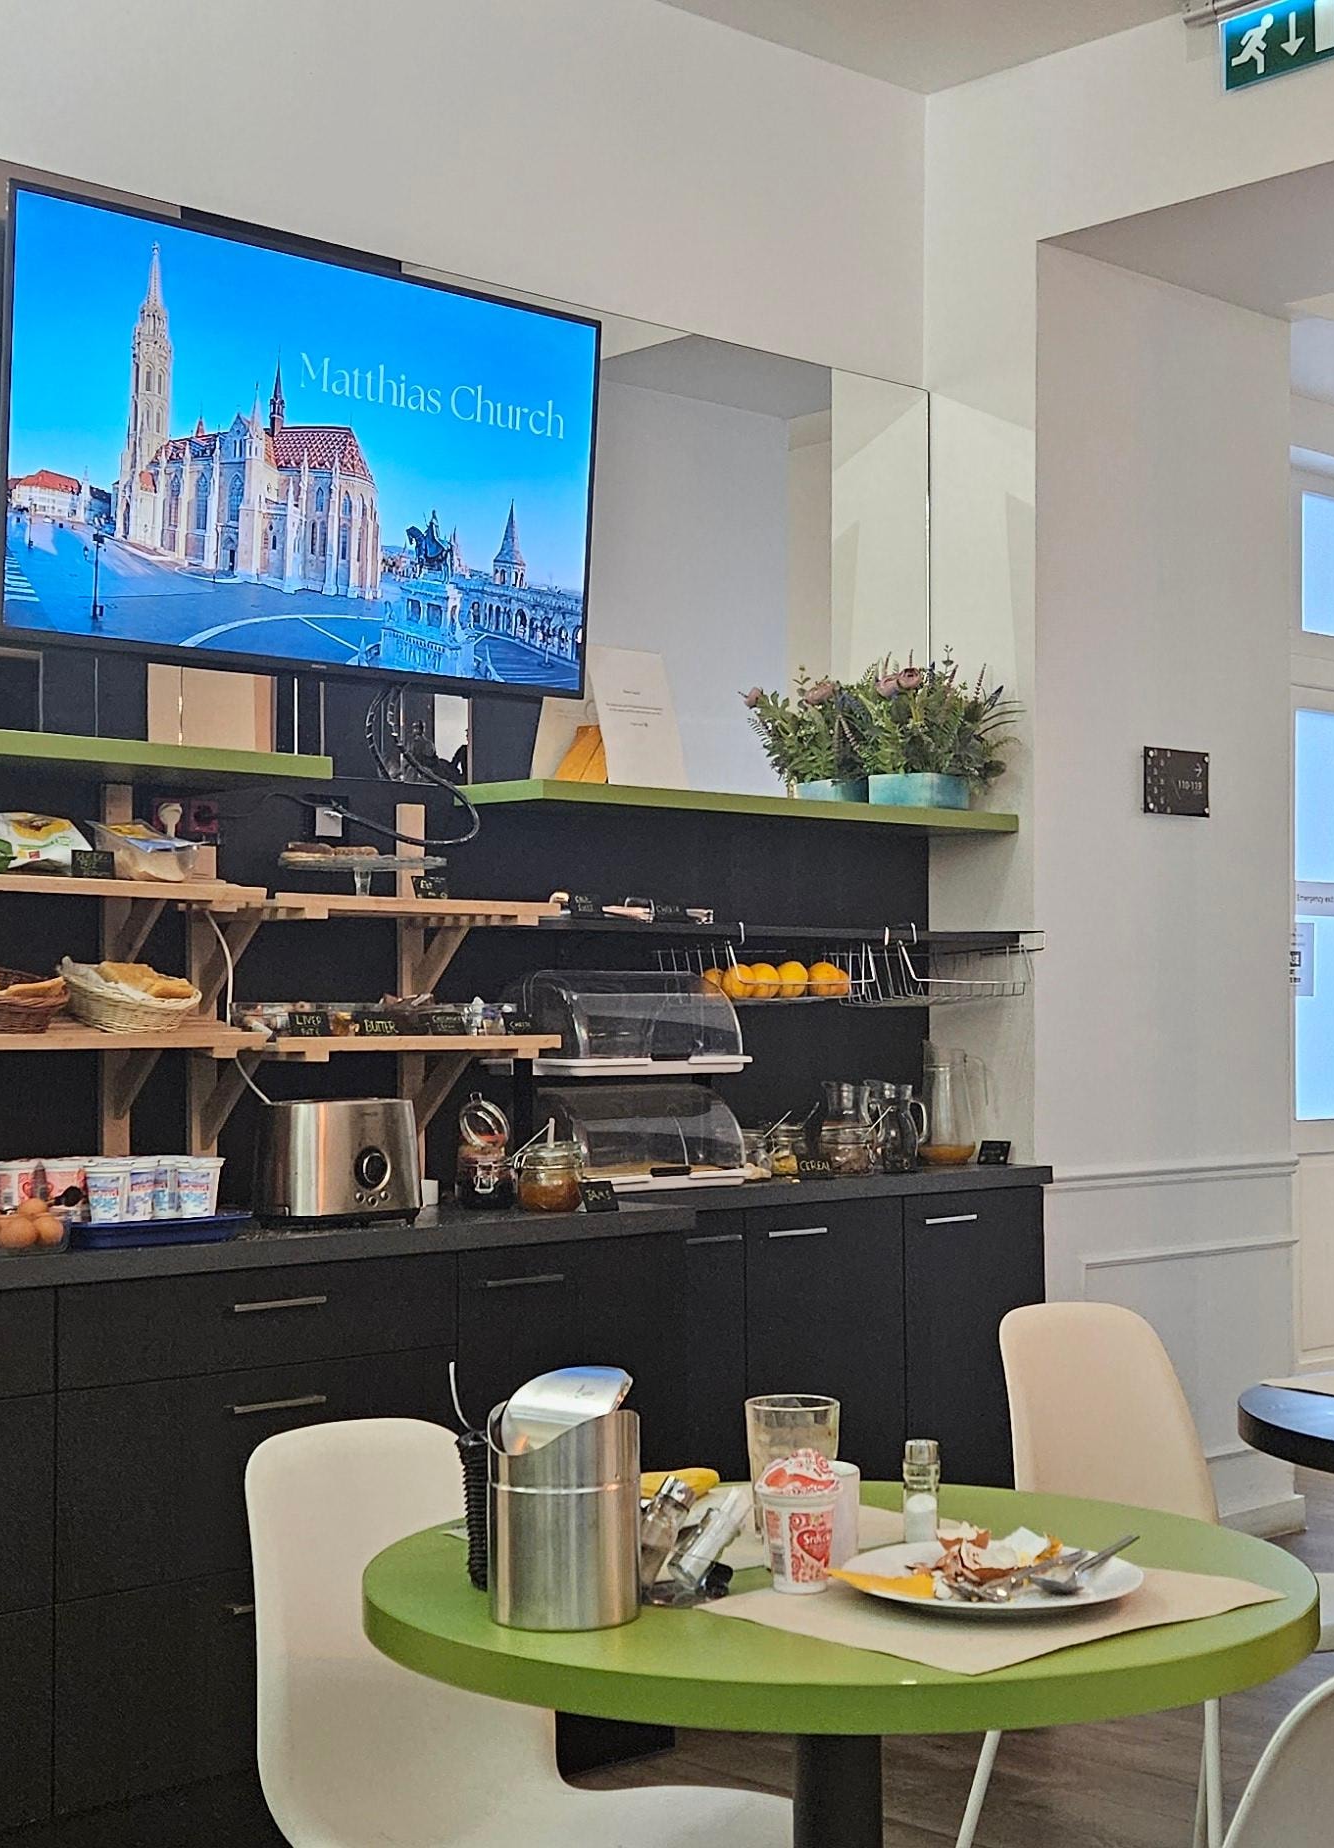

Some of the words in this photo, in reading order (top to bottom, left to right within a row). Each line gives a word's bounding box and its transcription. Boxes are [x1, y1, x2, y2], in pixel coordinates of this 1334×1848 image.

[299, 351, 442, 415] Matthias
[450, 384, 565, 440] Church
[364, 1019, 398, 1033] BUTTER
